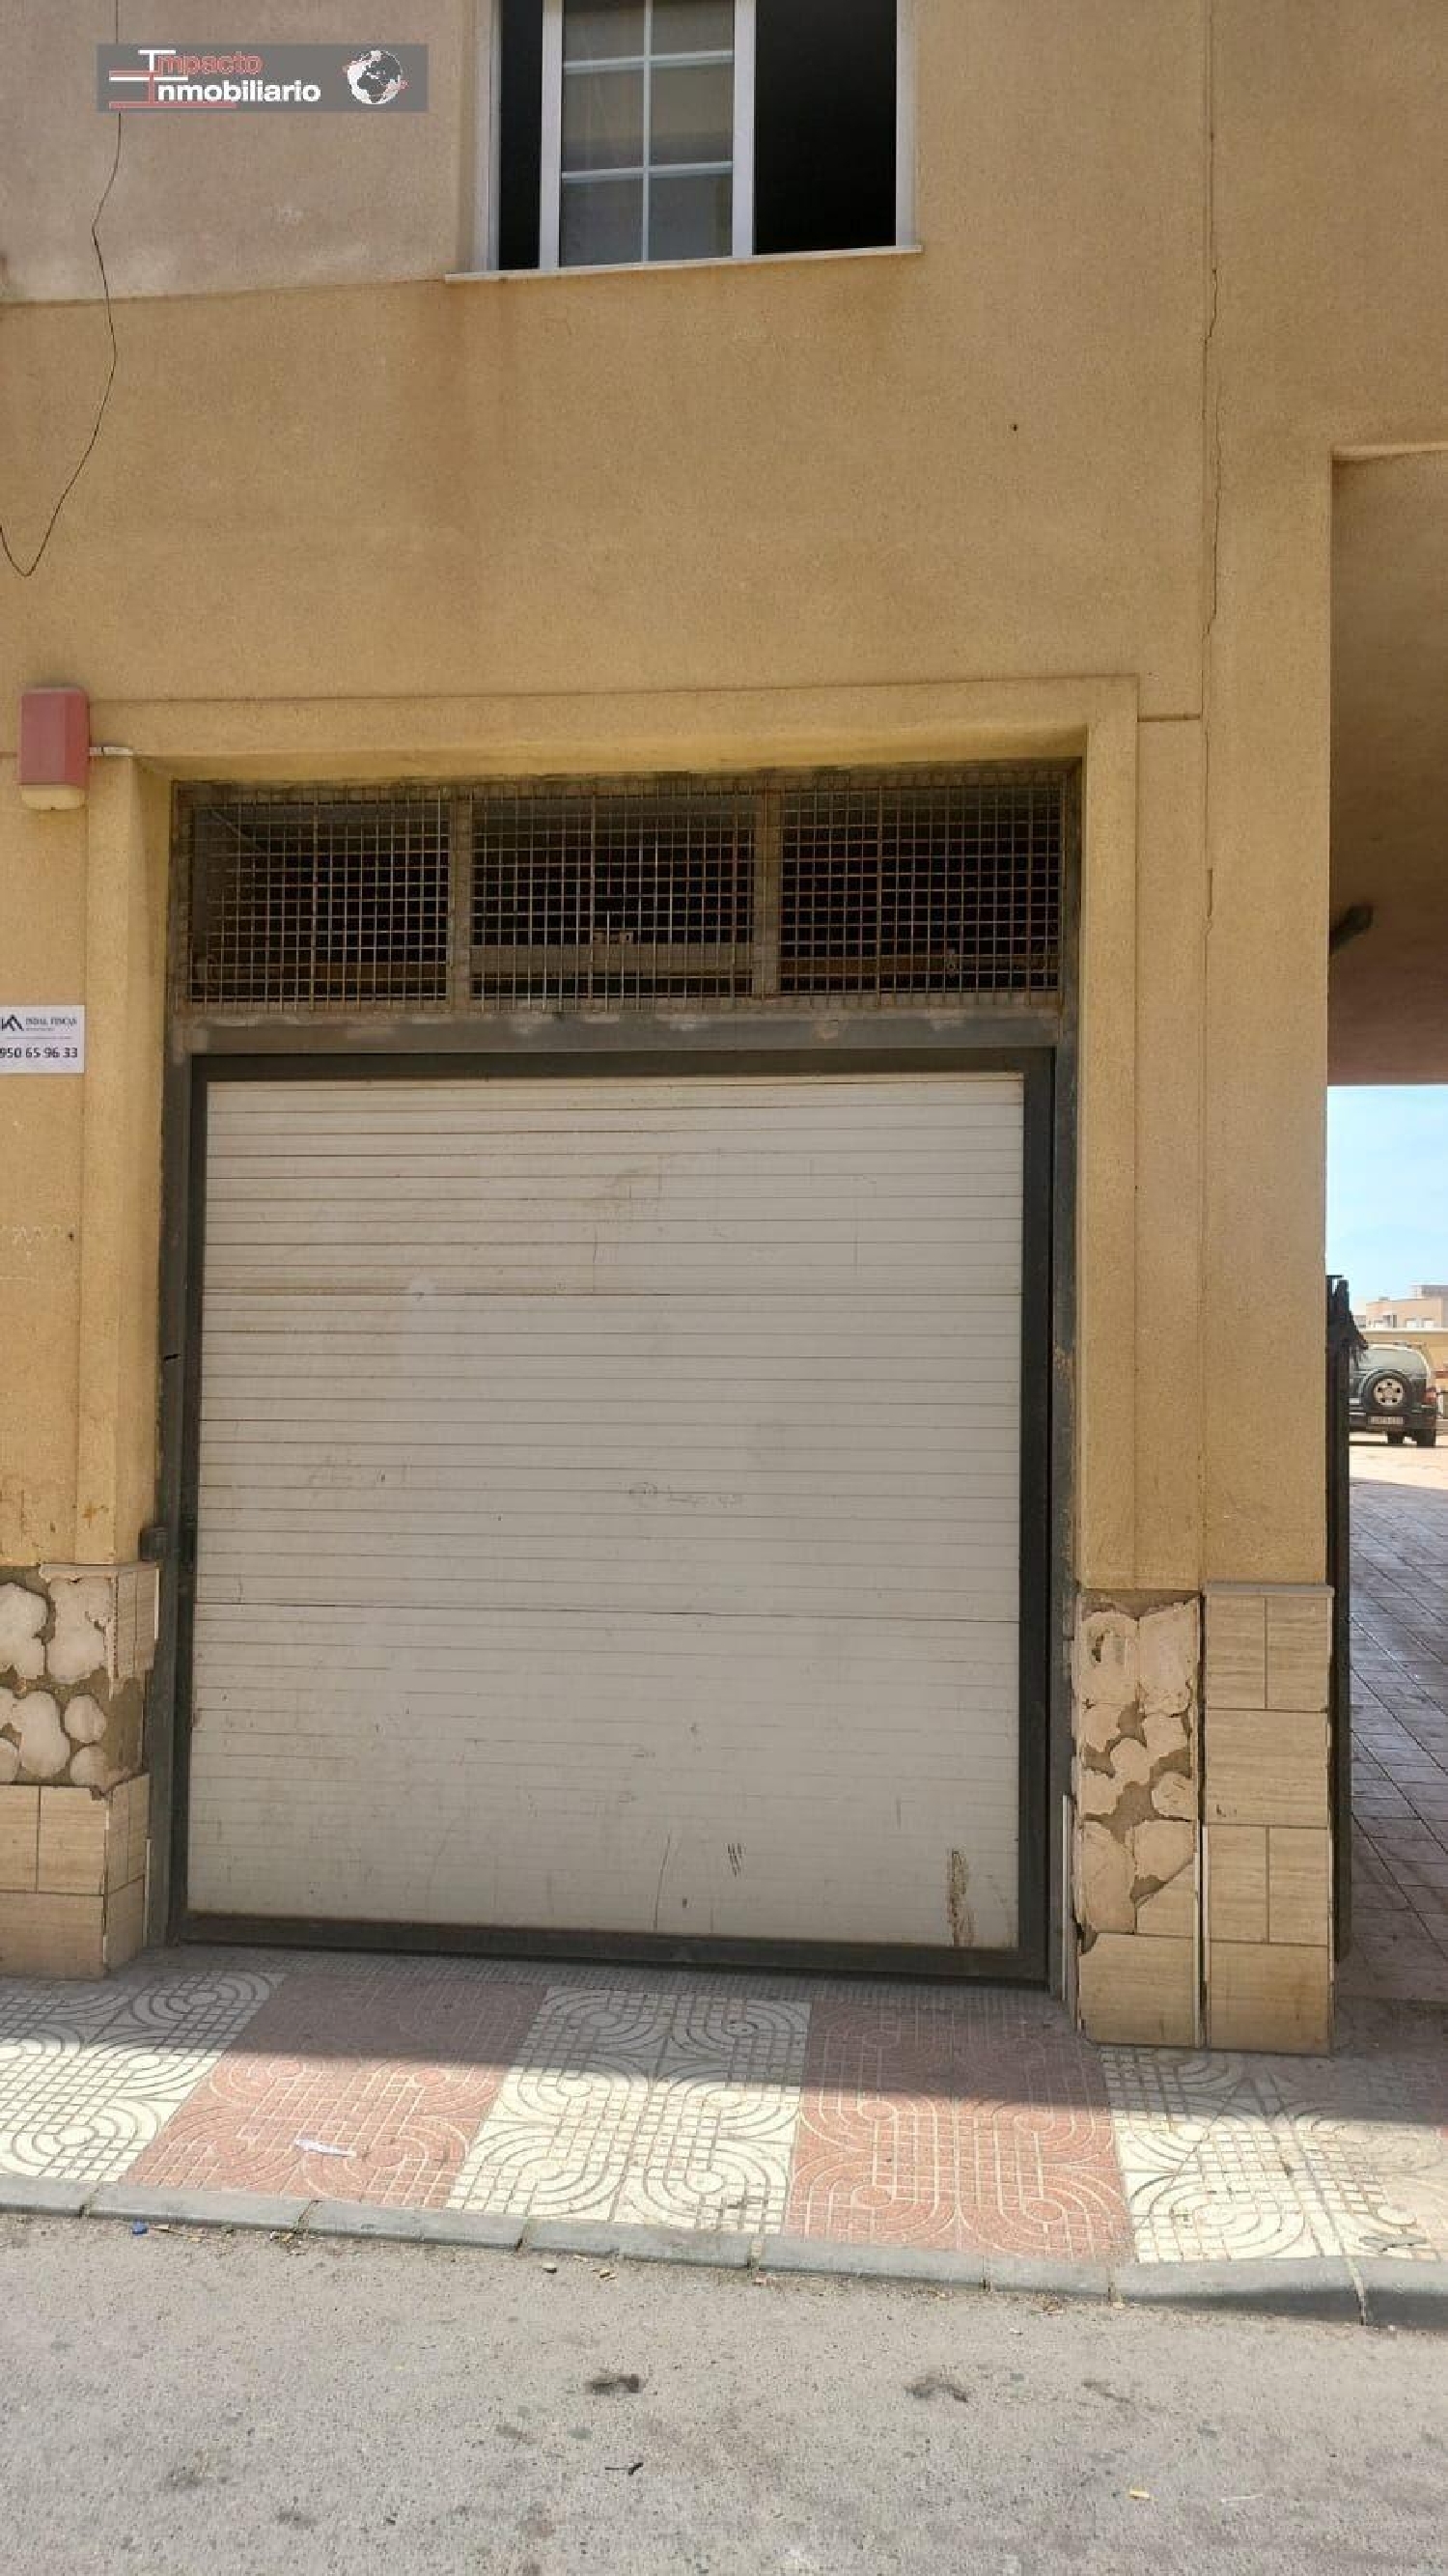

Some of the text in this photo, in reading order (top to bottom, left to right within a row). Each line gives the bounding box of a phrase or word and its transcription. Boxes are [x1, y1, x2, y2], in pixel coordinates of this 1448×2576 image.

[0, 1047, 78, 1058] 950 65 96 33
